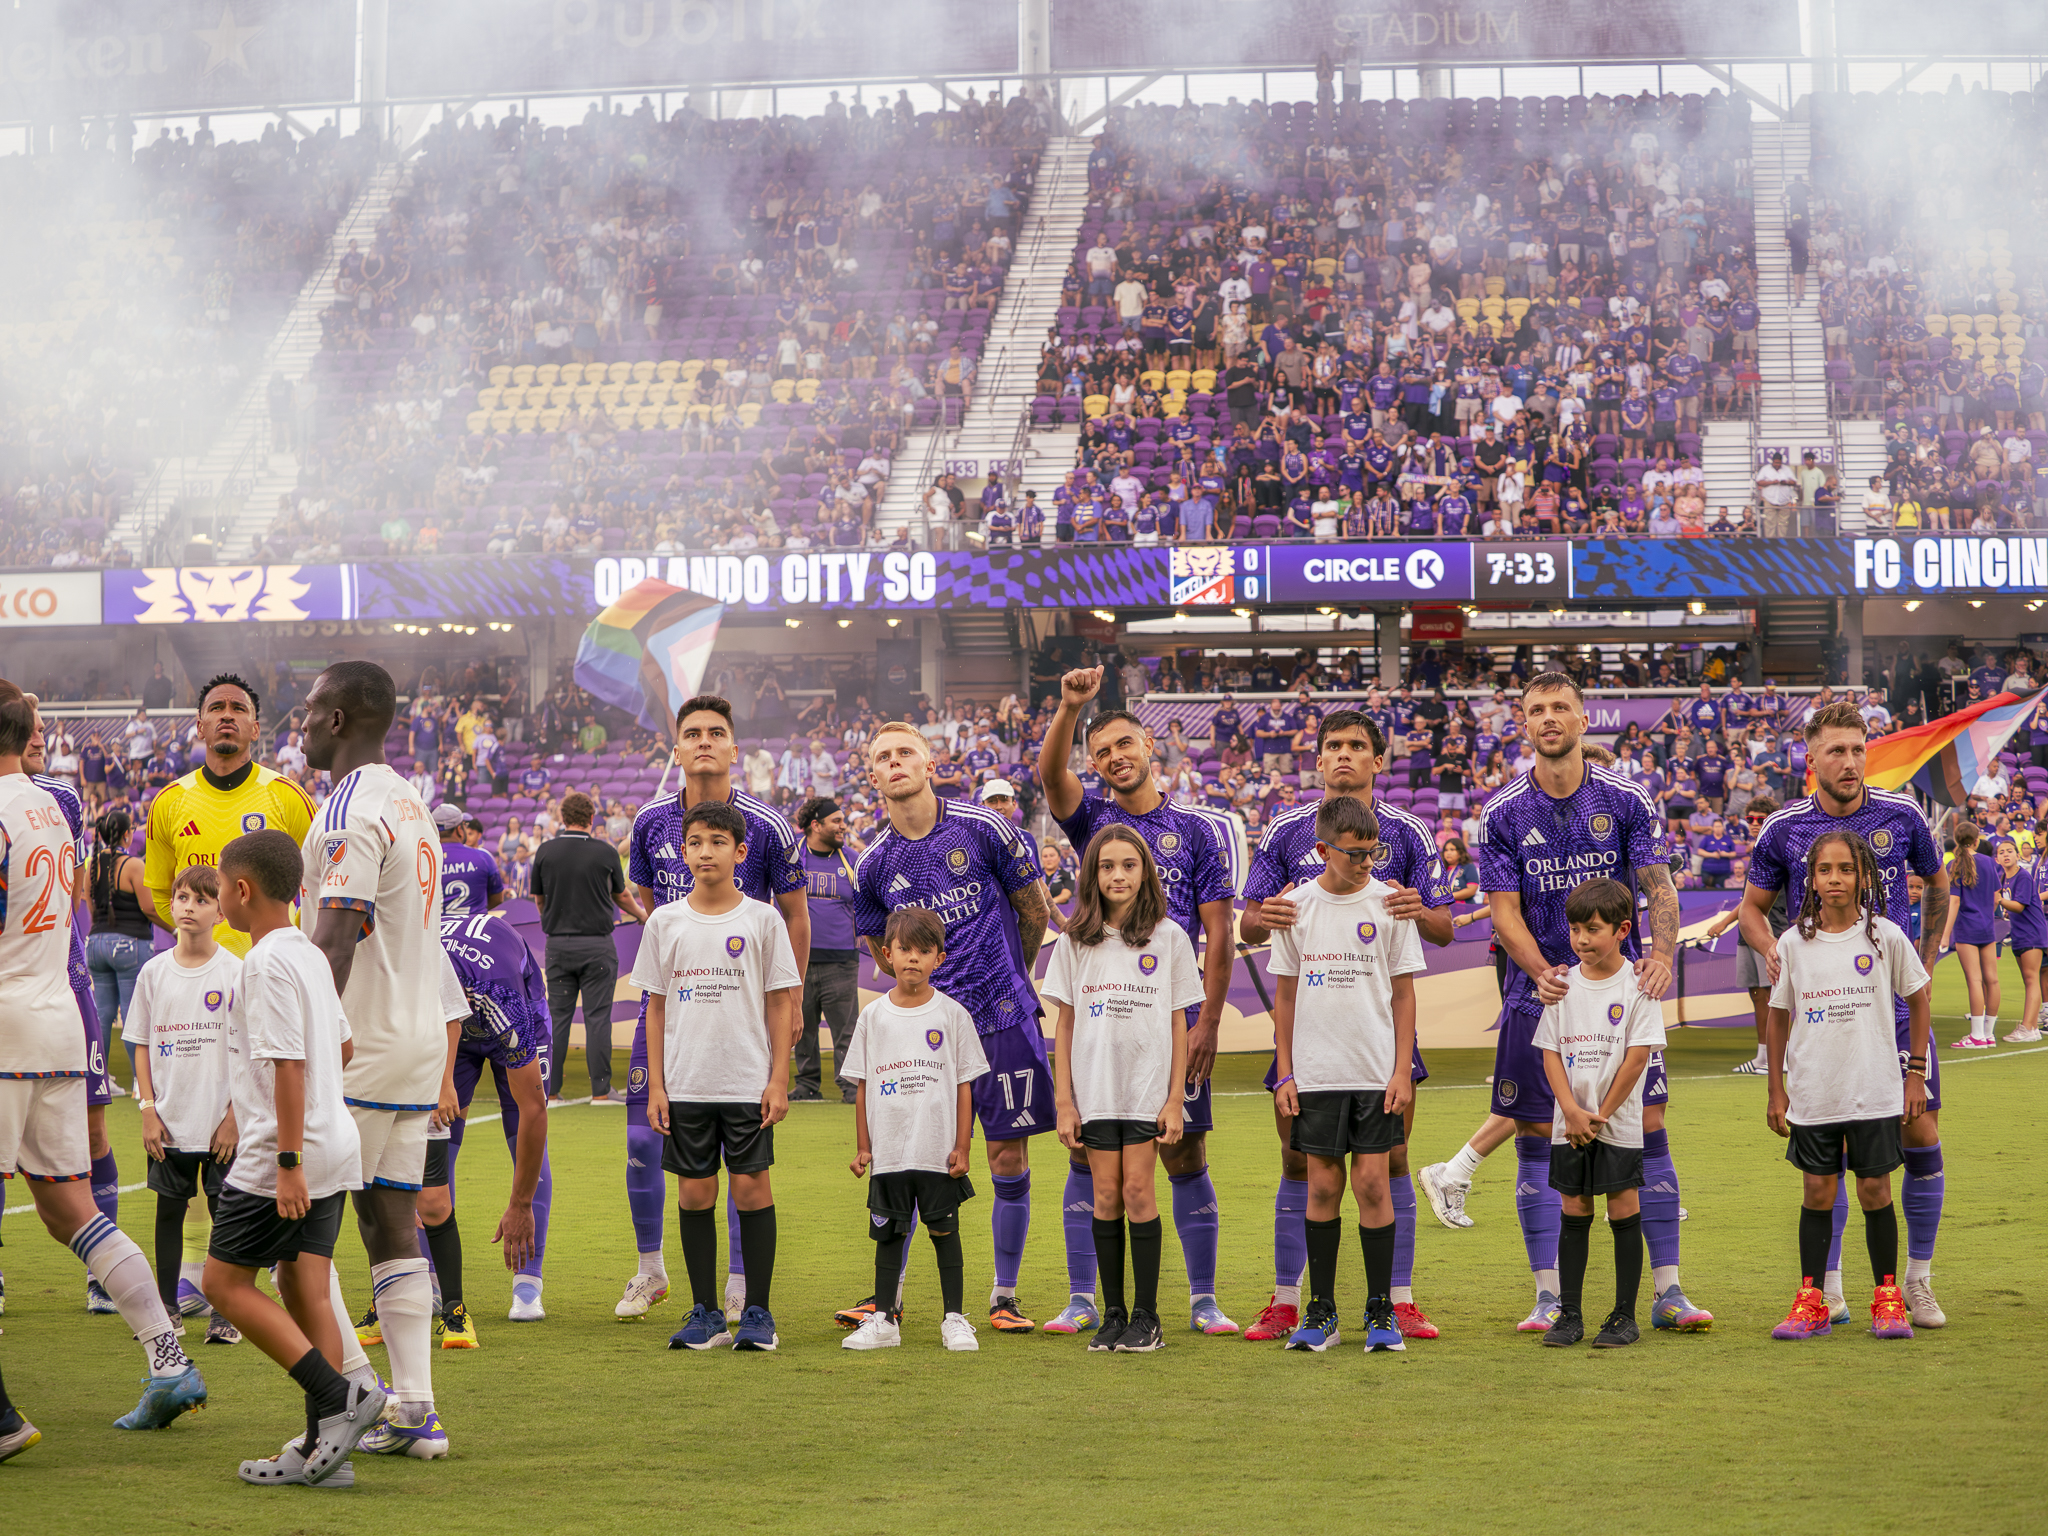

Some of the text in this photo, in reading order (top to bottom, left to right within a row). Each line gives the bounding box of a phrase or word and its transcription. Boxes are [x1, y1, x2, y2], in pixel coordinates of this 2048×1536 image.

[1333, 11, 1519, 47] STADIUM
[0, 27, 168, 84] eken
[946, 461, 976, 477] 133
[1243, 548, 1258, 571] 0
[1303, 552, 1444, 588] CIRCLE K
[1487, 552, 1556, 585] 7:33
[1854, 538, 2048, 588] FC CINCIN
[781, 551, 871, 604] CITY
[883, 551, 936, 602] SC
[1244, 576, 1259, 599] 0
[1584, 708, 1620, 728] UM
[1526, 851, 1617, 875] ORLANDO
[417, 837, 436, 930] 9
[441, 879, 470, 914] 2
[712, 967, 744, 977] HEALTH
[1082, 983, 1156, 994] ORLANDO HEALTH
[1843, 986, 1875, 995] HEALTH
[1130, 1000, 1152, 1008] Palmer
[154, 1022, 221, 1033] ORLANDO HEALTH
[90, 1041, 104, 1075] 6
[876, 1059, 942, 1074] ORLANDO HEALTH
[997, 1068, 1034, 1110] 17
